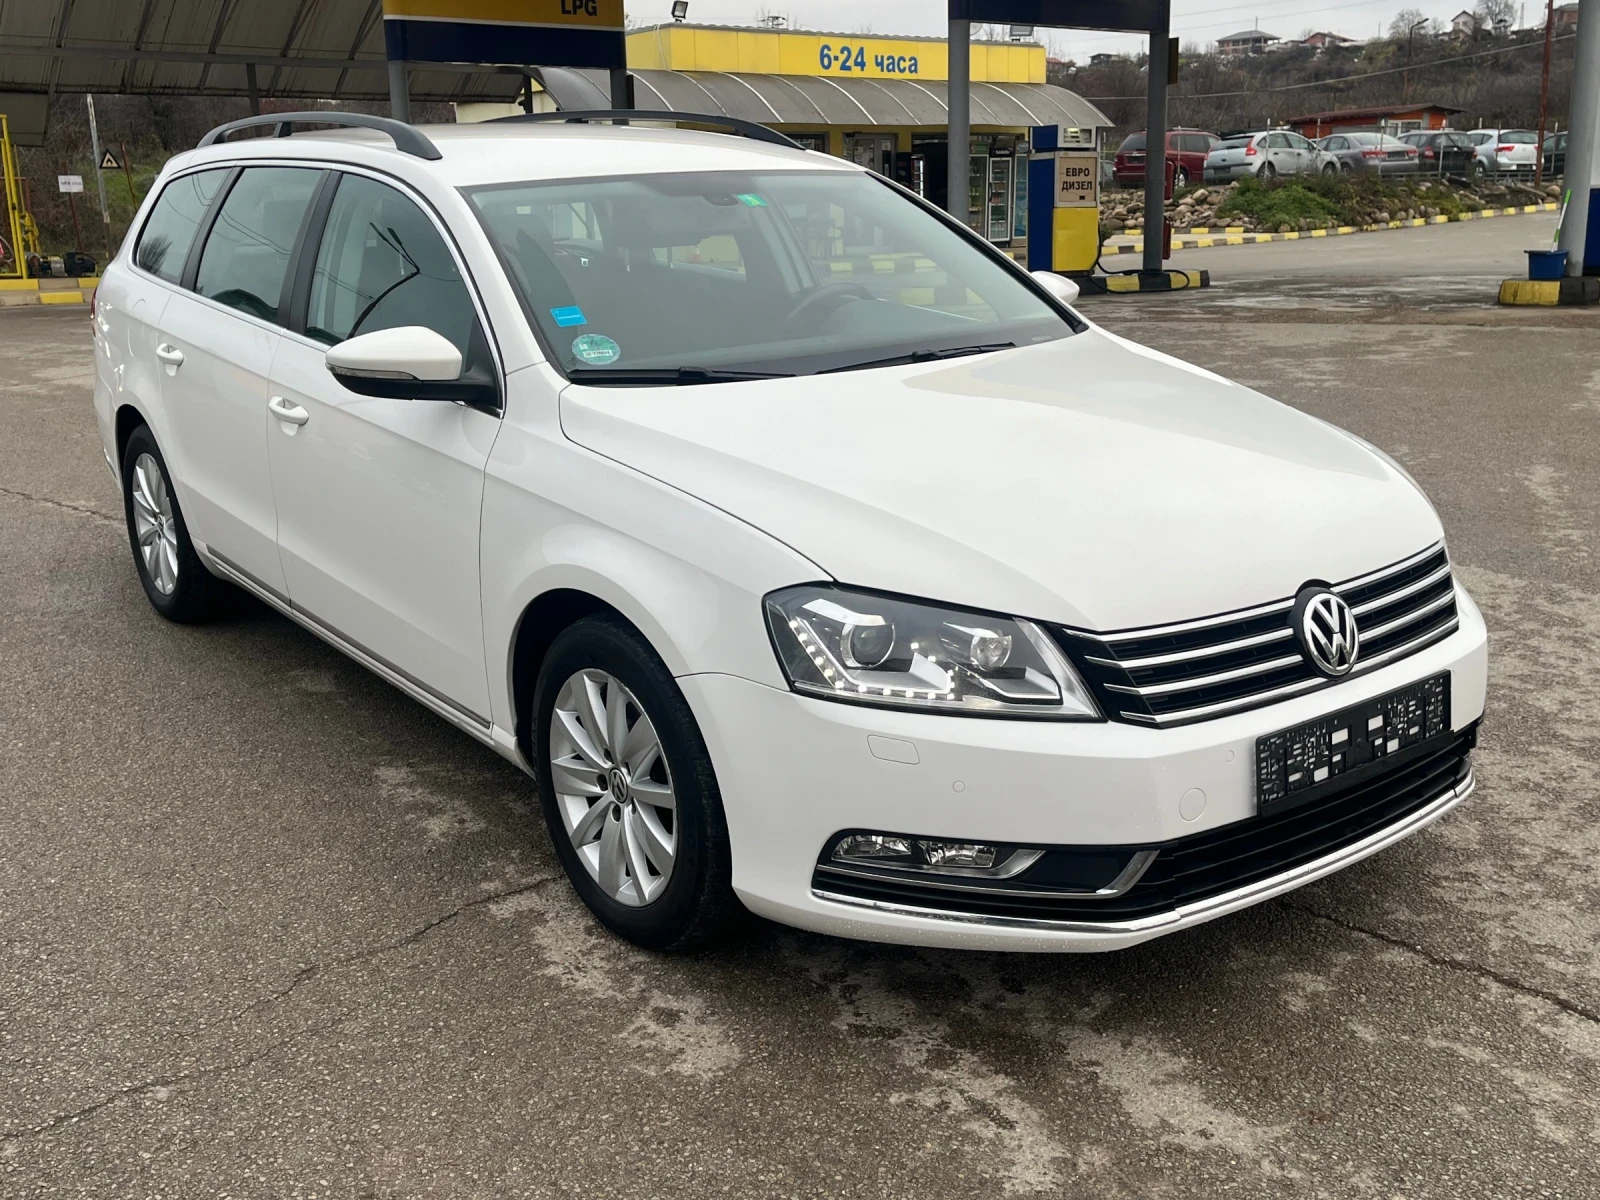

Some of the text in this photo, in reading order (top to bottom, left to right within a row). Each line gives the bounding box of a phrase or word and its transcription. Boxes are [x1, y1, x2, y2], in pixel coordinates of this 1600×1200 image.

[561, 0, 598, 17] LPG
[819, 44, 919, 74] 6-24 часа
[1065, 167, 1091, 177] ЕВРО
[1061, 181, 1093, 192] ДИЗЕЛ
[1305, 594, 1357, 674] VW
